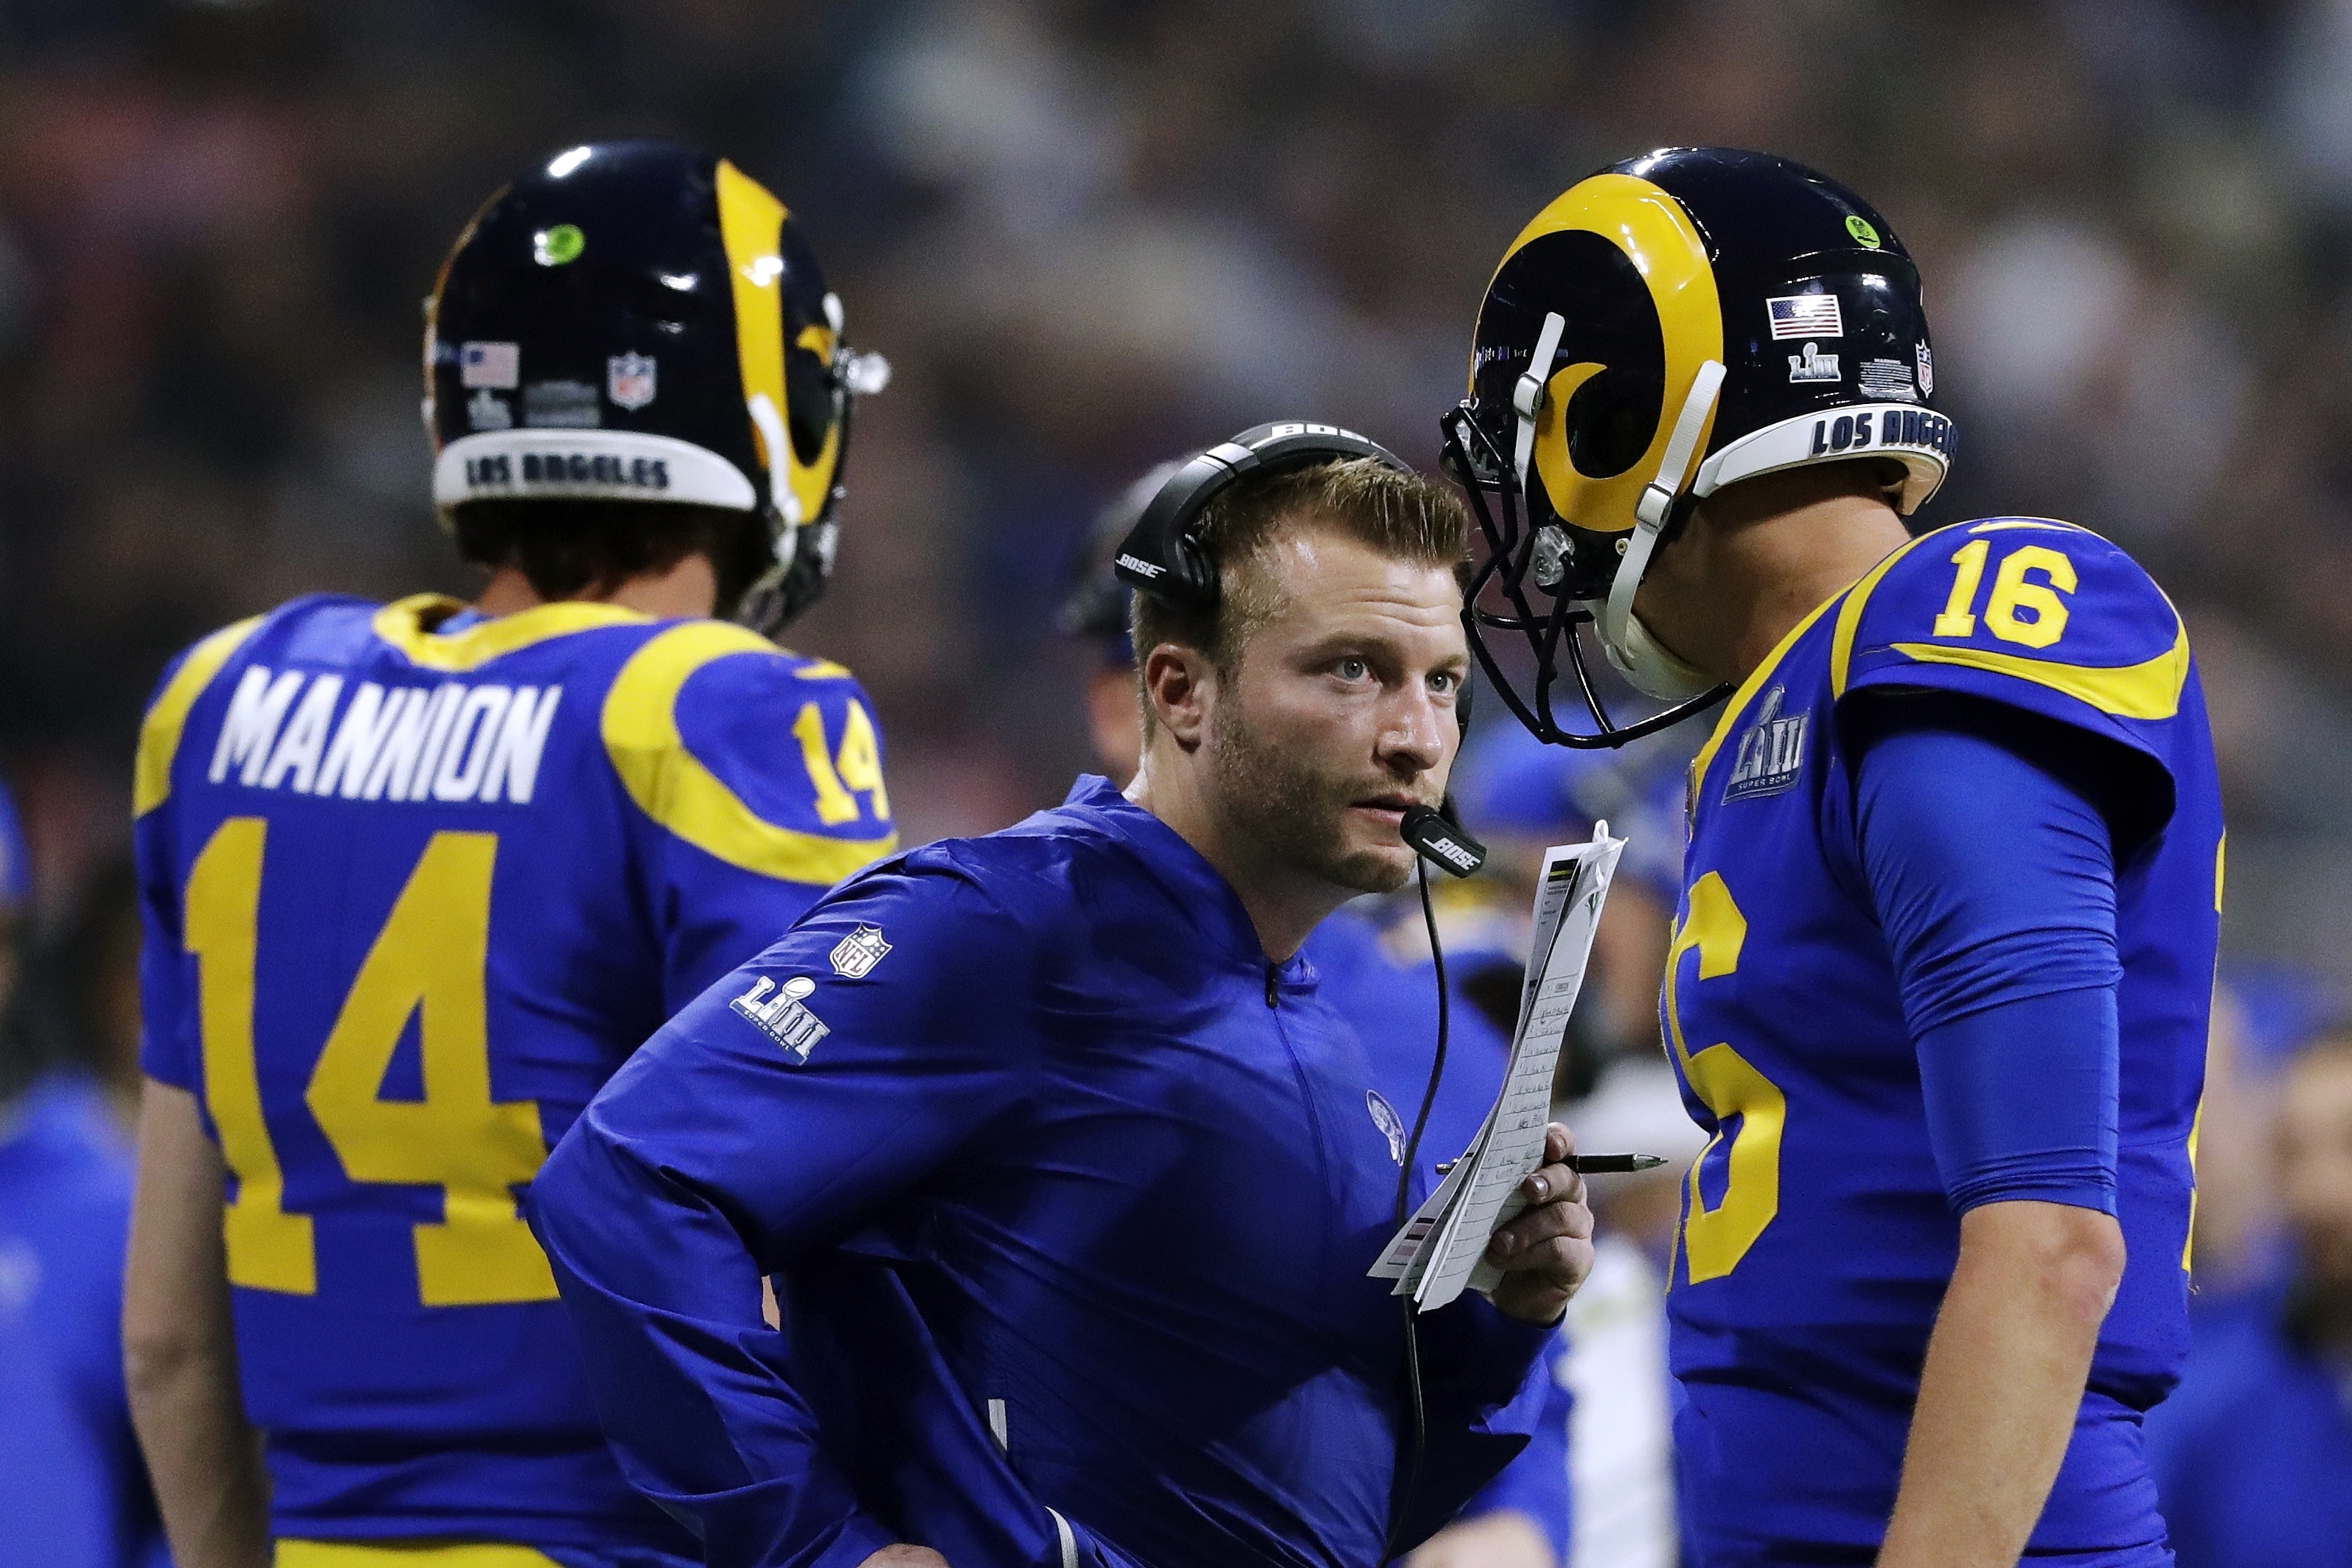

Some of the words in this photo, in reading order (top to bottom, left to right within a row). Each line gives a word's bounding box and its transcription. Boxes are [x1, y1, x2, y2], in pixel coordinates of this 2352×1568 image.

[1812, 413, 1873, 456] LOS
[465, 454, 509, 486] LOS
[521, 452, 668, 488] ANGELES
[1115, 553, 1167, 579] BOSE
[1932, 540, 2078, 649] 16
[209, 665, 563, 805] MANNION
[792, 698, 890, 825] 14
[1737, 778, 1766, 790] SUPER
[1422, 837, 1481, 871] BOSE
[835, 941, 869, 973] NFL
[734, 975, 831, 1056] LIII
[743, 1010, 768, 1031] SUPER
[769, 1030, 790, 1051] BOWL
[184, 816, 560, 1306] 14
